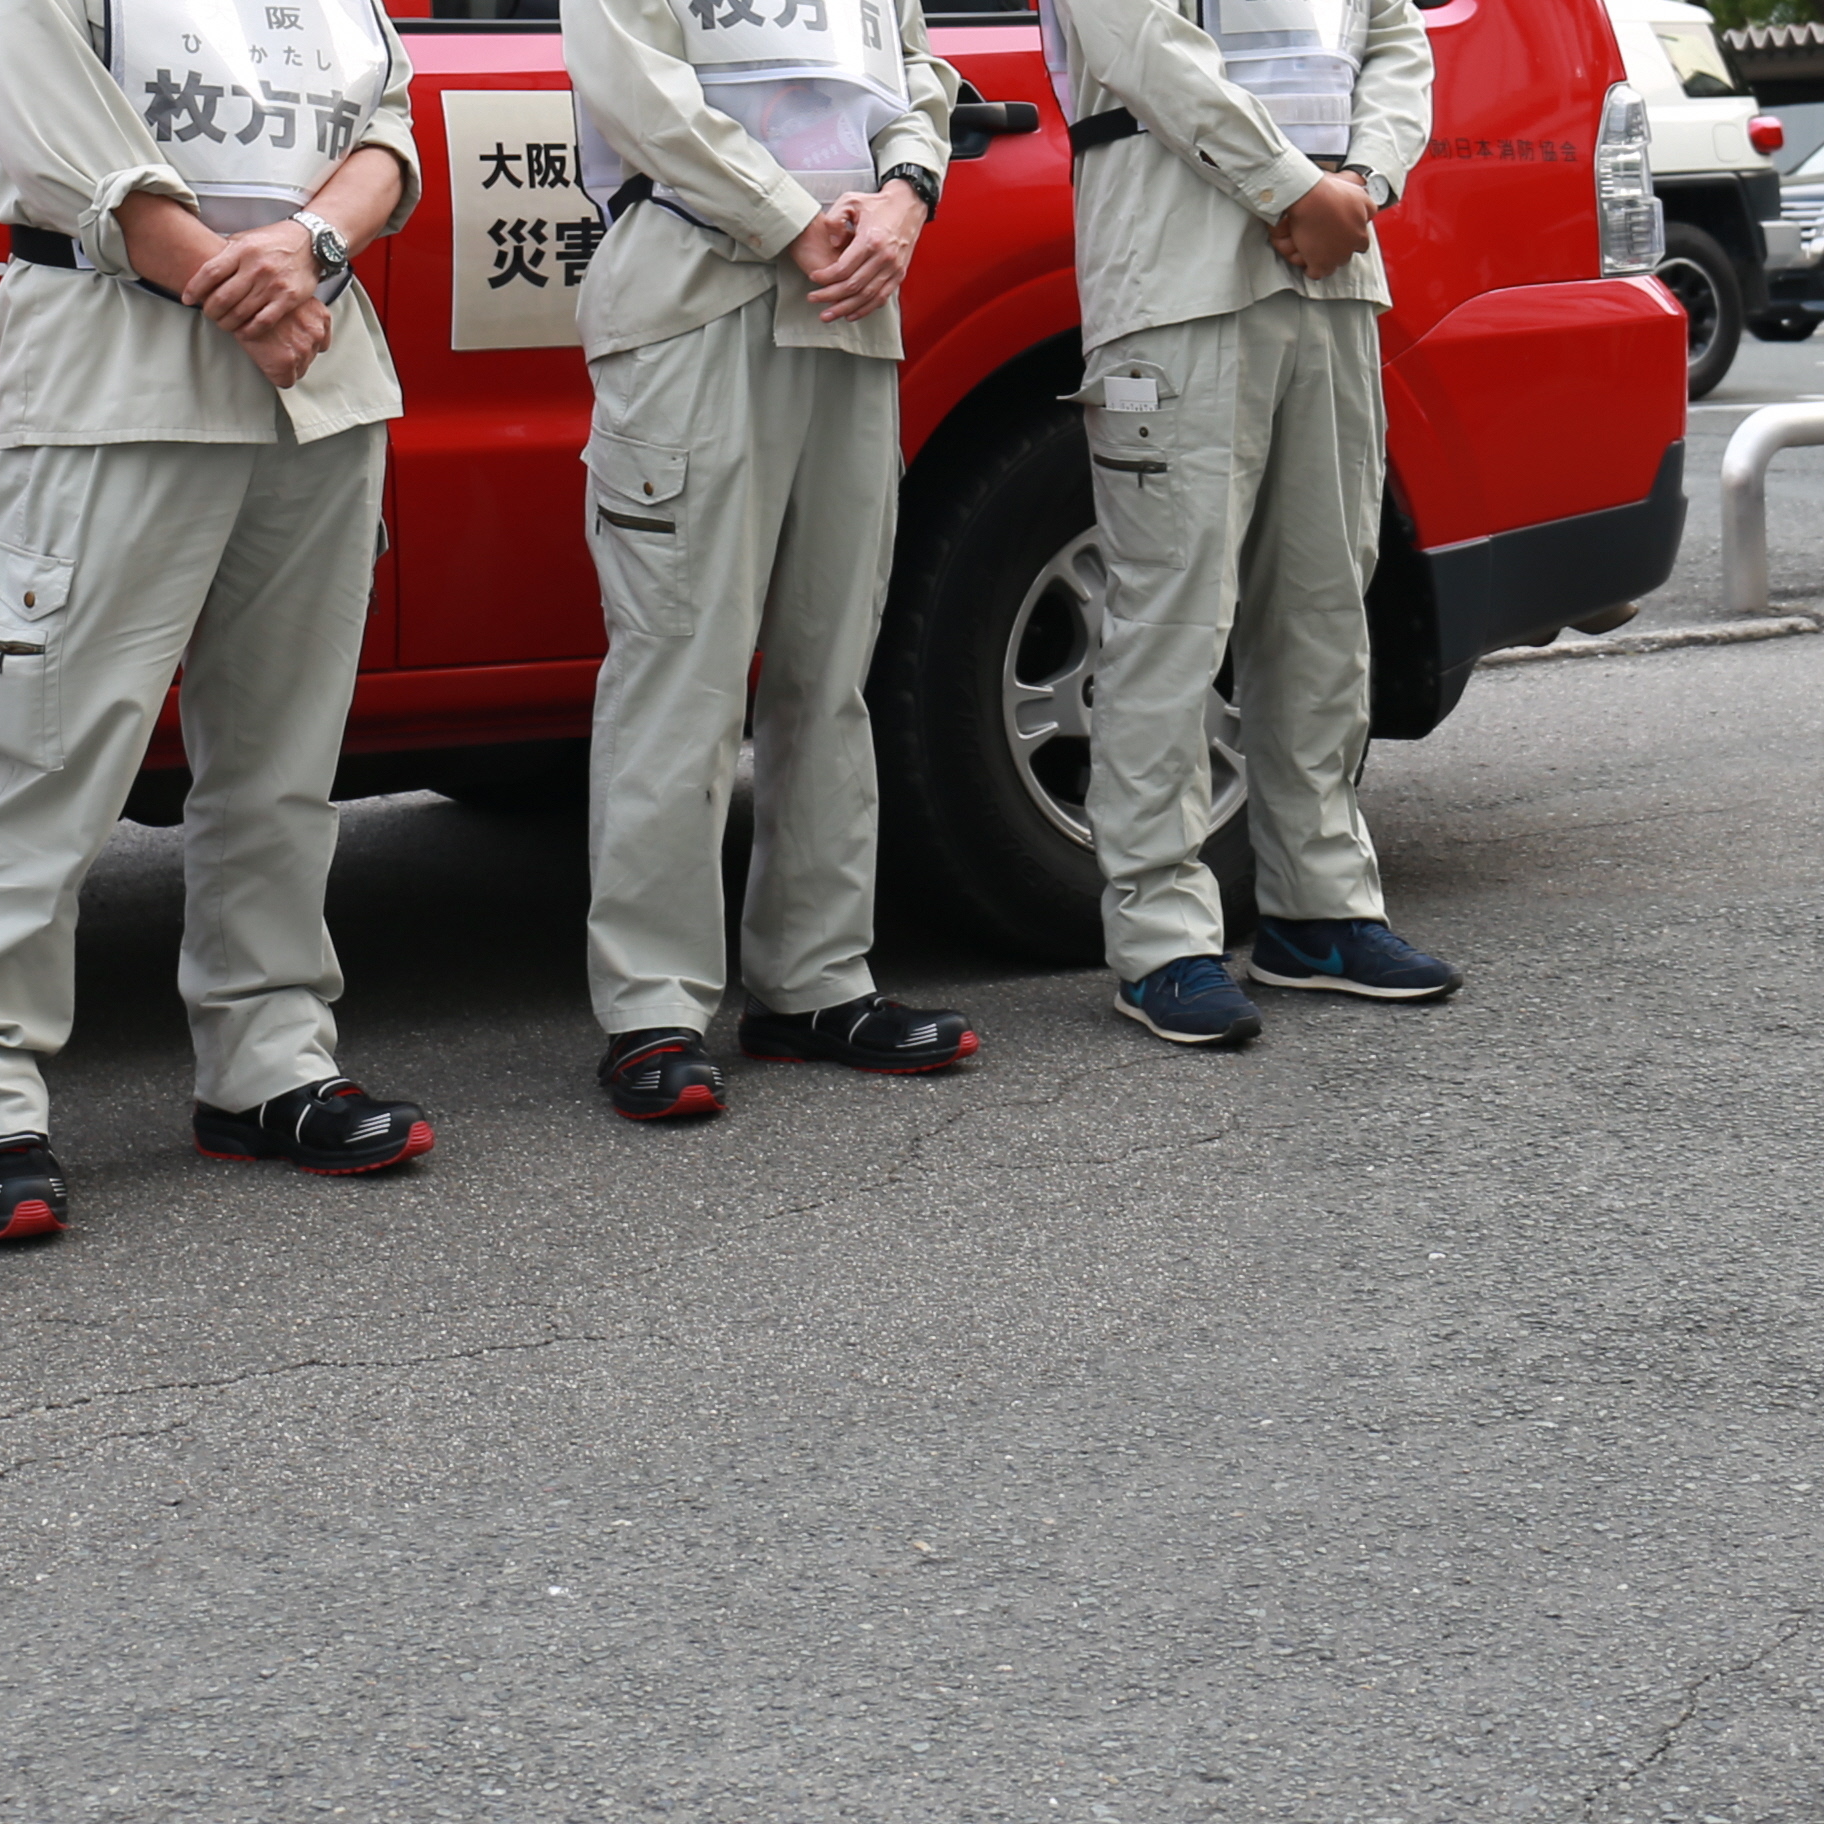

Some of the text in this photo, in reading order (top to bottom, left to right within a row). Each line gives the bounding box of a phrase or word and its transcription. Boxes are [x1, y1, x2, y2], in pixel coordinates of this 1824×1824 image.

[182, 33, 332, 71] ひかたし
[144, 69, 361, 161] 枚方市
[487, 217, 607, 289] 災害
